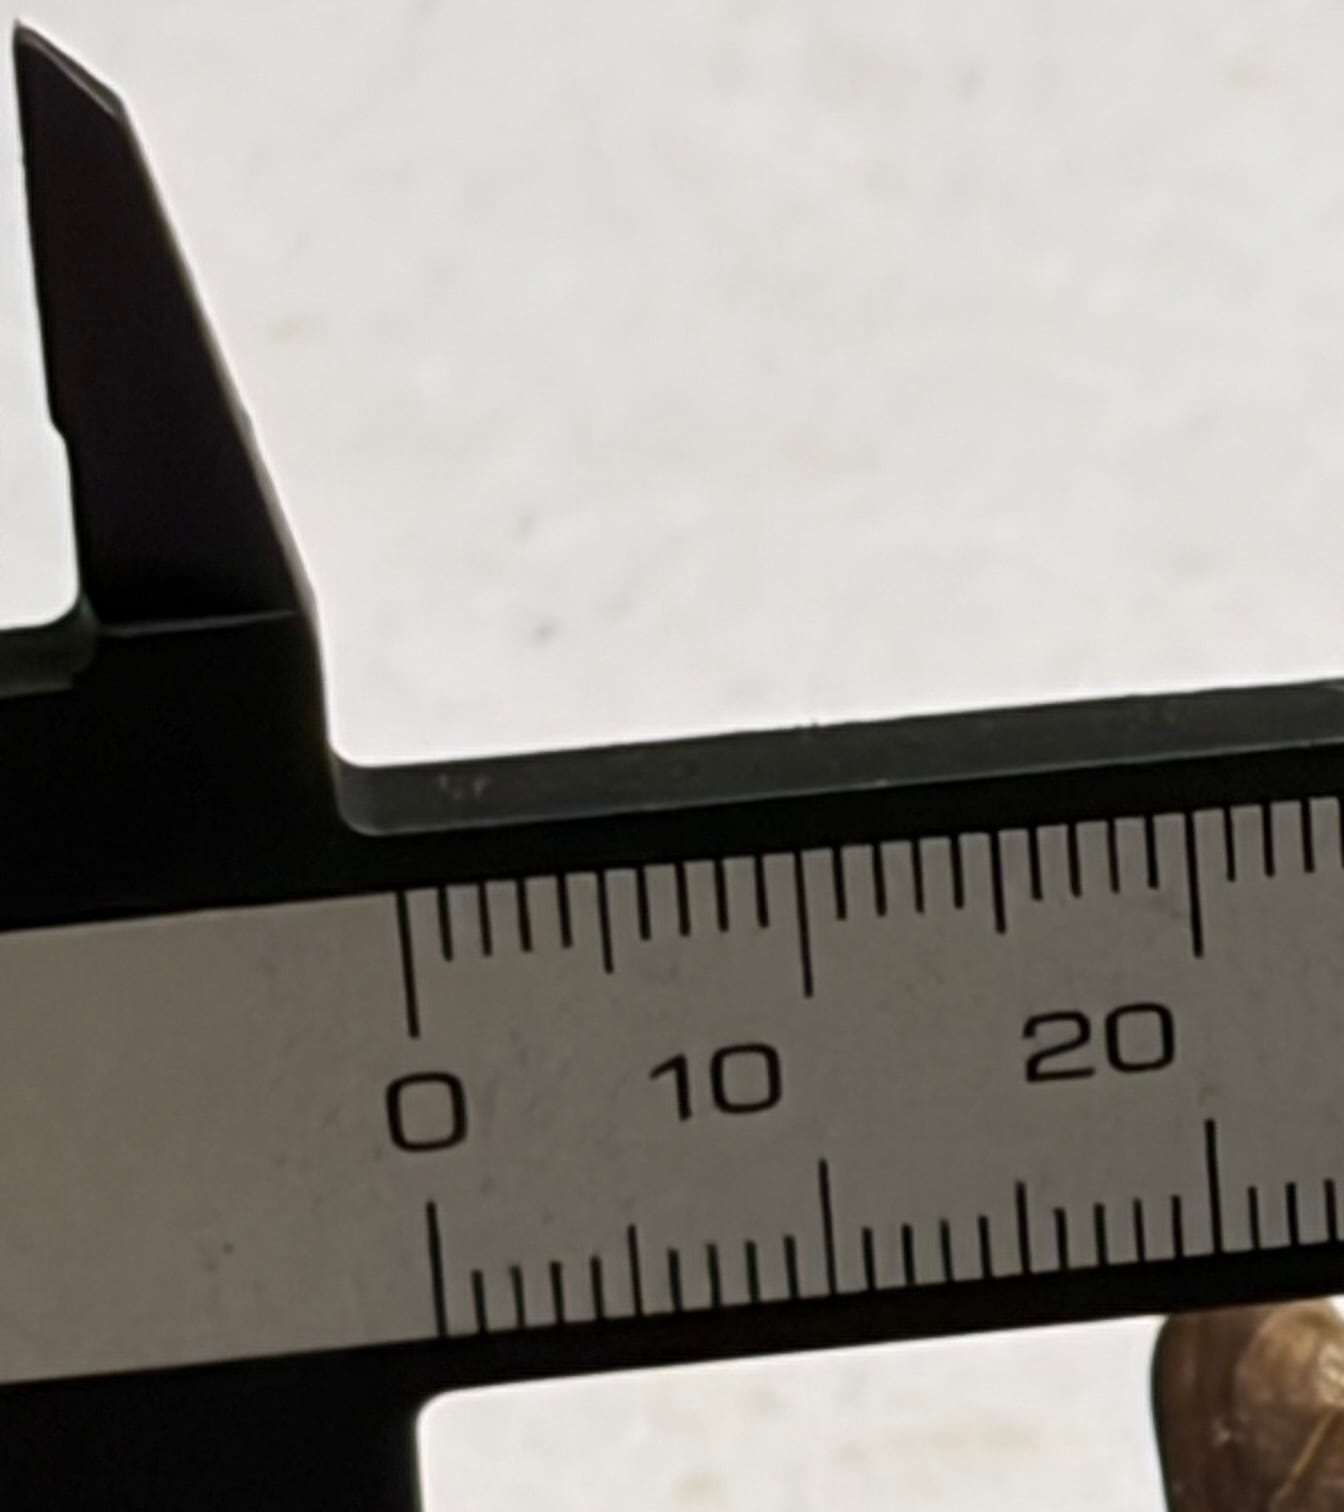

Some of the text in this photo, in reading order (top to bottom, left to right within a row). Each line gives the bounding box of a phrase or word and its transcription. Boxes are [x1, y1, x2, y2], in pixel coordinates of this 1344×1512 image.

[385, 1072, 468, 1153] 0
[649, 1042, 783, 1121] 10
[1022, 1003, 1176, 1082] 20
